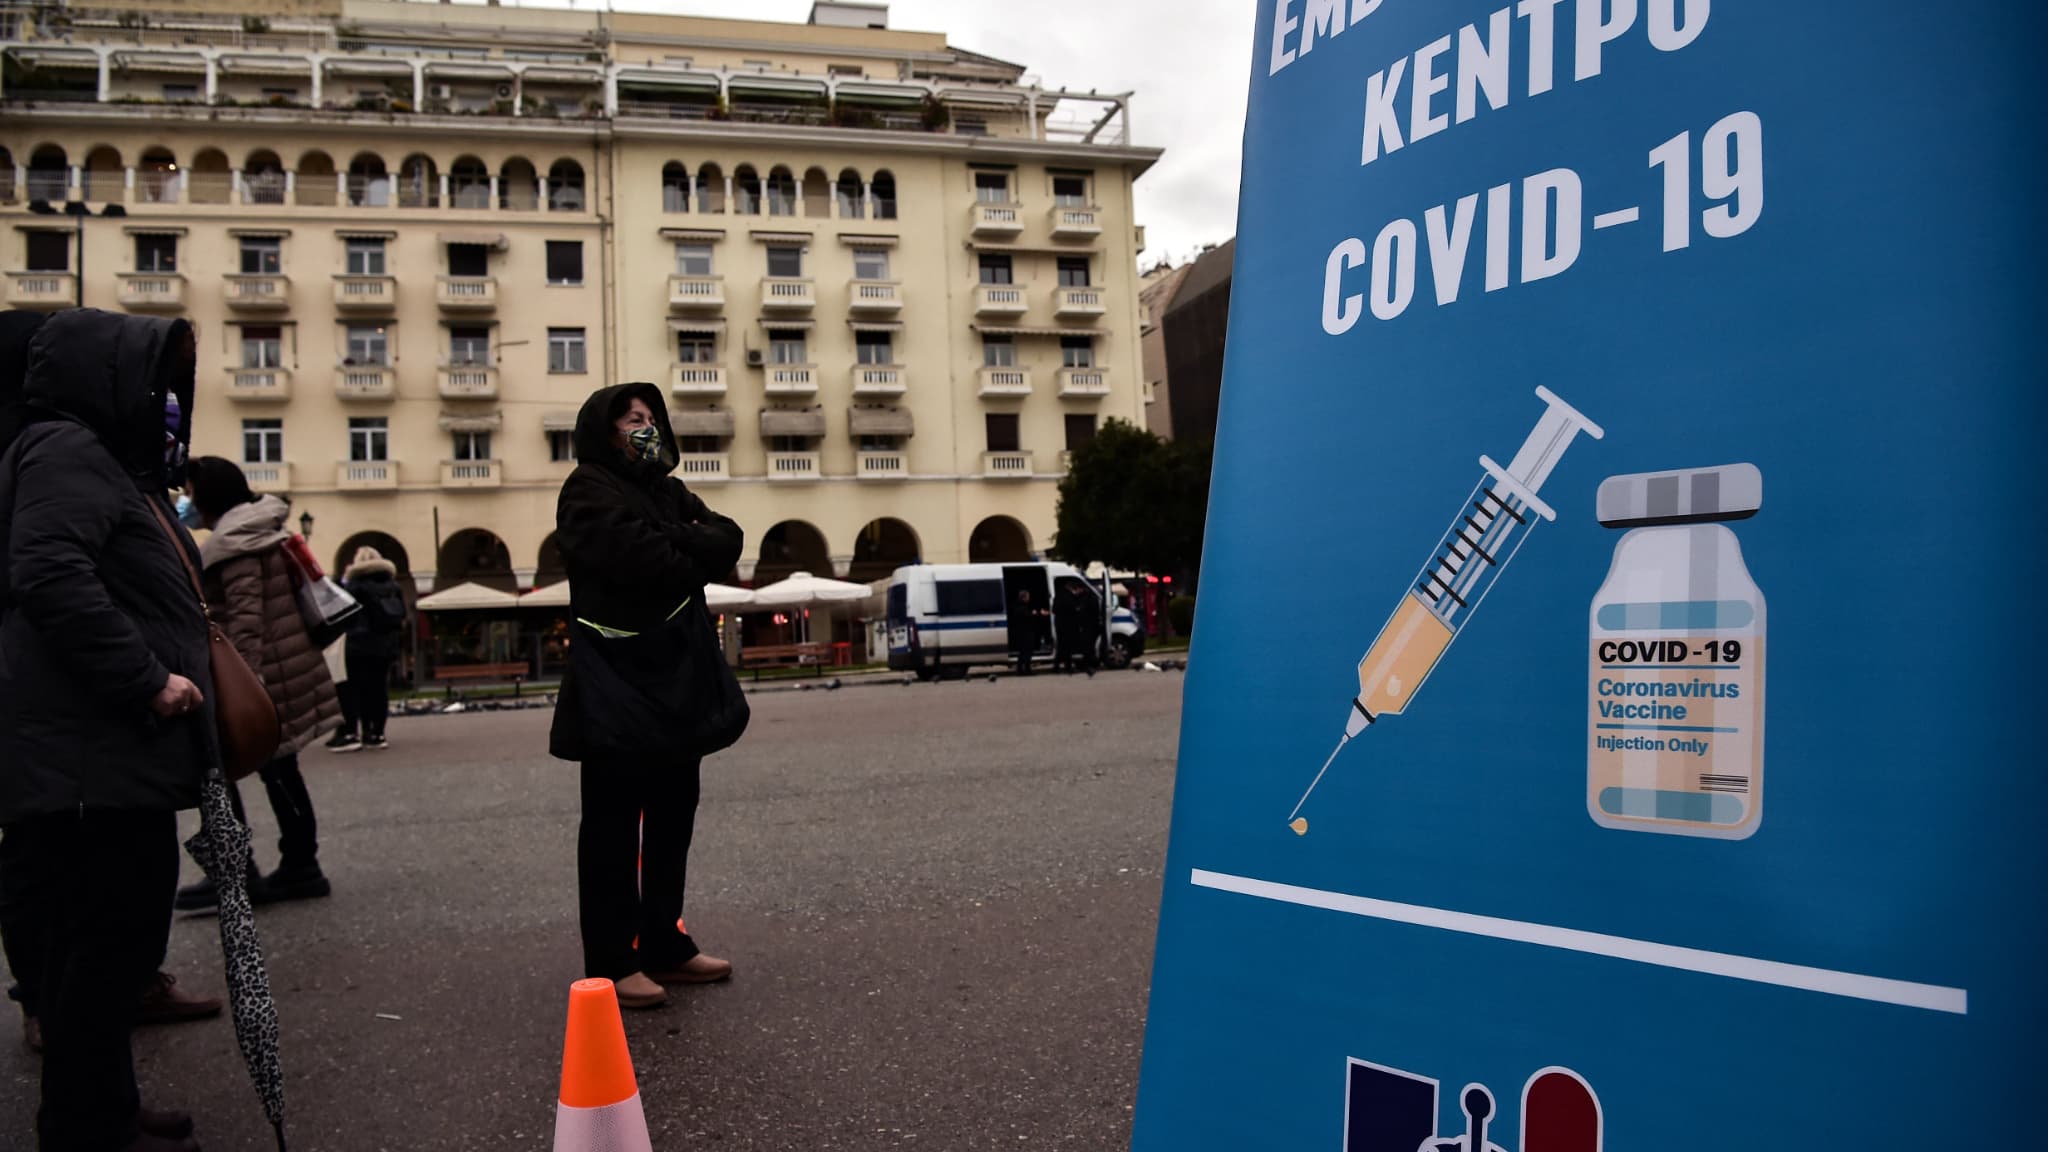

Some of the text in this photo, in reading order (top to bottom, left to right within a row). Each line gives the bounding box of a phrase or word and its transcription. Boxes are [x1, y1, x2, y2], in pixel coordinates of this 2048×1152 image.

[1321, 110, 1764, 336] COVID-19
[1598, 678, 1740, 698] Coronavirus
[1598, 700, 1687, 720] Vaccine
[1597, 735, 1708, 756] Injection Only
